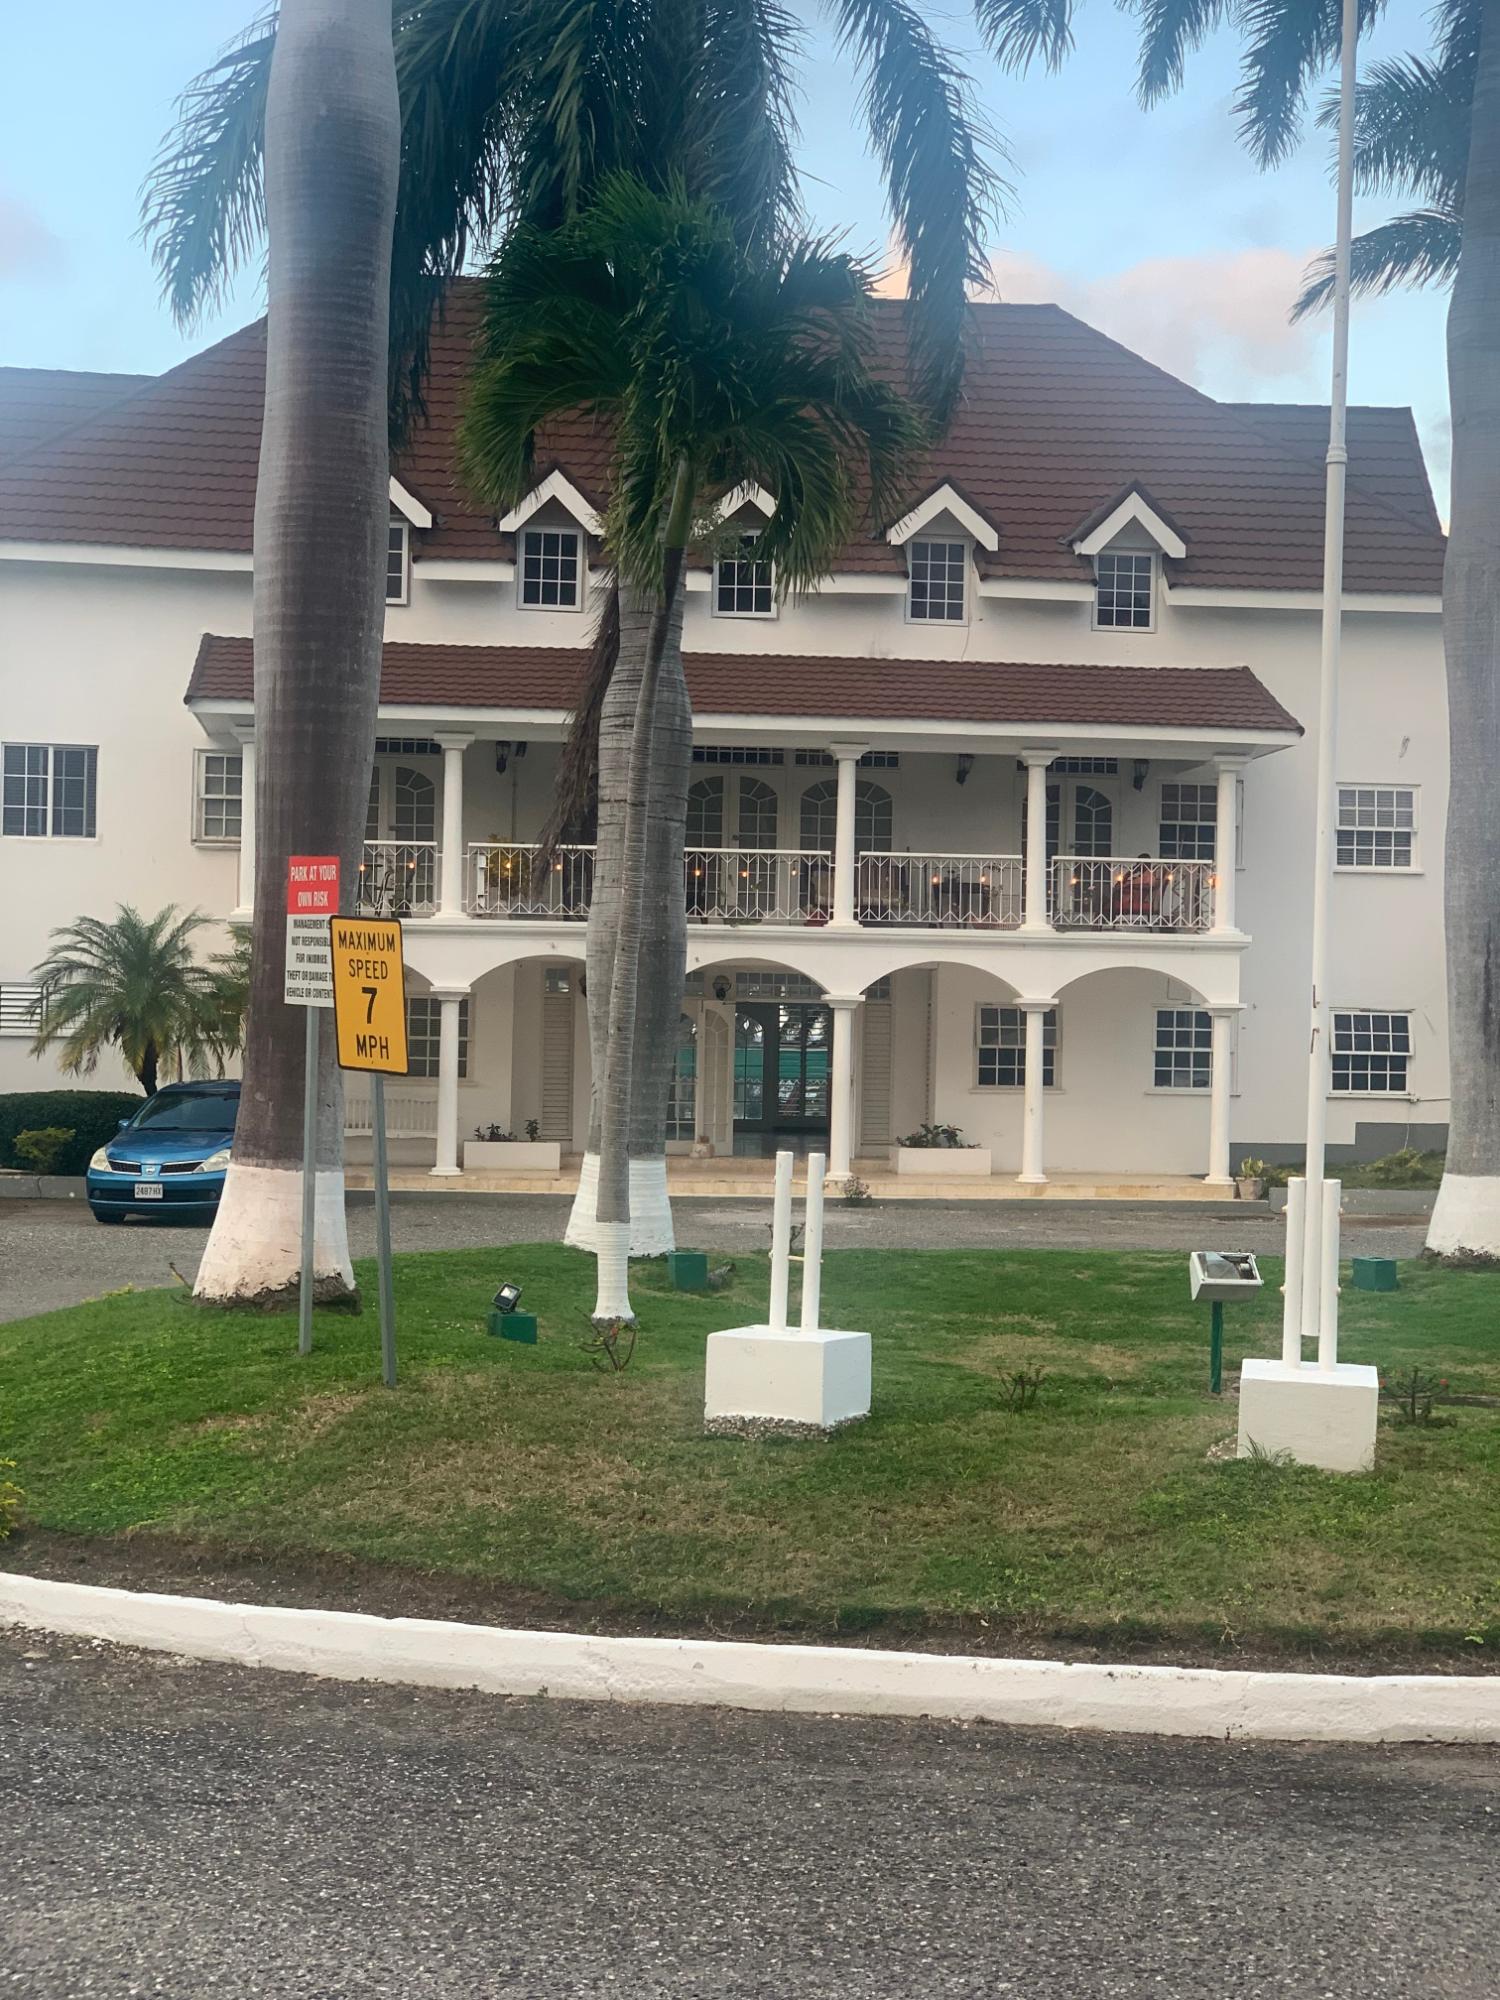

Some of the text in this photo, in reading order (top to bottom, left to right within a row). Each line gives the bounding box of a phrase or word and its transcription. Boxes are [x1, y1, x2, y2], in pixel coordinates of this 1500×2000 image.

[290, 864, 336, 882] PARK AT YOUR
[298, 891, 328, 907] OWN RISK
[293, 919, 325, 929] MANAGEMENT
[291, 936, 331, 947] NOT RESPONSIBL
[338, 930, 396, 953] MAXIMUM
[296, 953, 305, 963] FOR
[287, 970, 332, 982] THEFT OR DAMAGE T
[348, 959, 388, 980] SPEED
[286, 987, 333, 999] VEHICLE OR CONTENT
[361, 987, 378, 1025] 7
[356, 1034, 389, 1060] MPH
